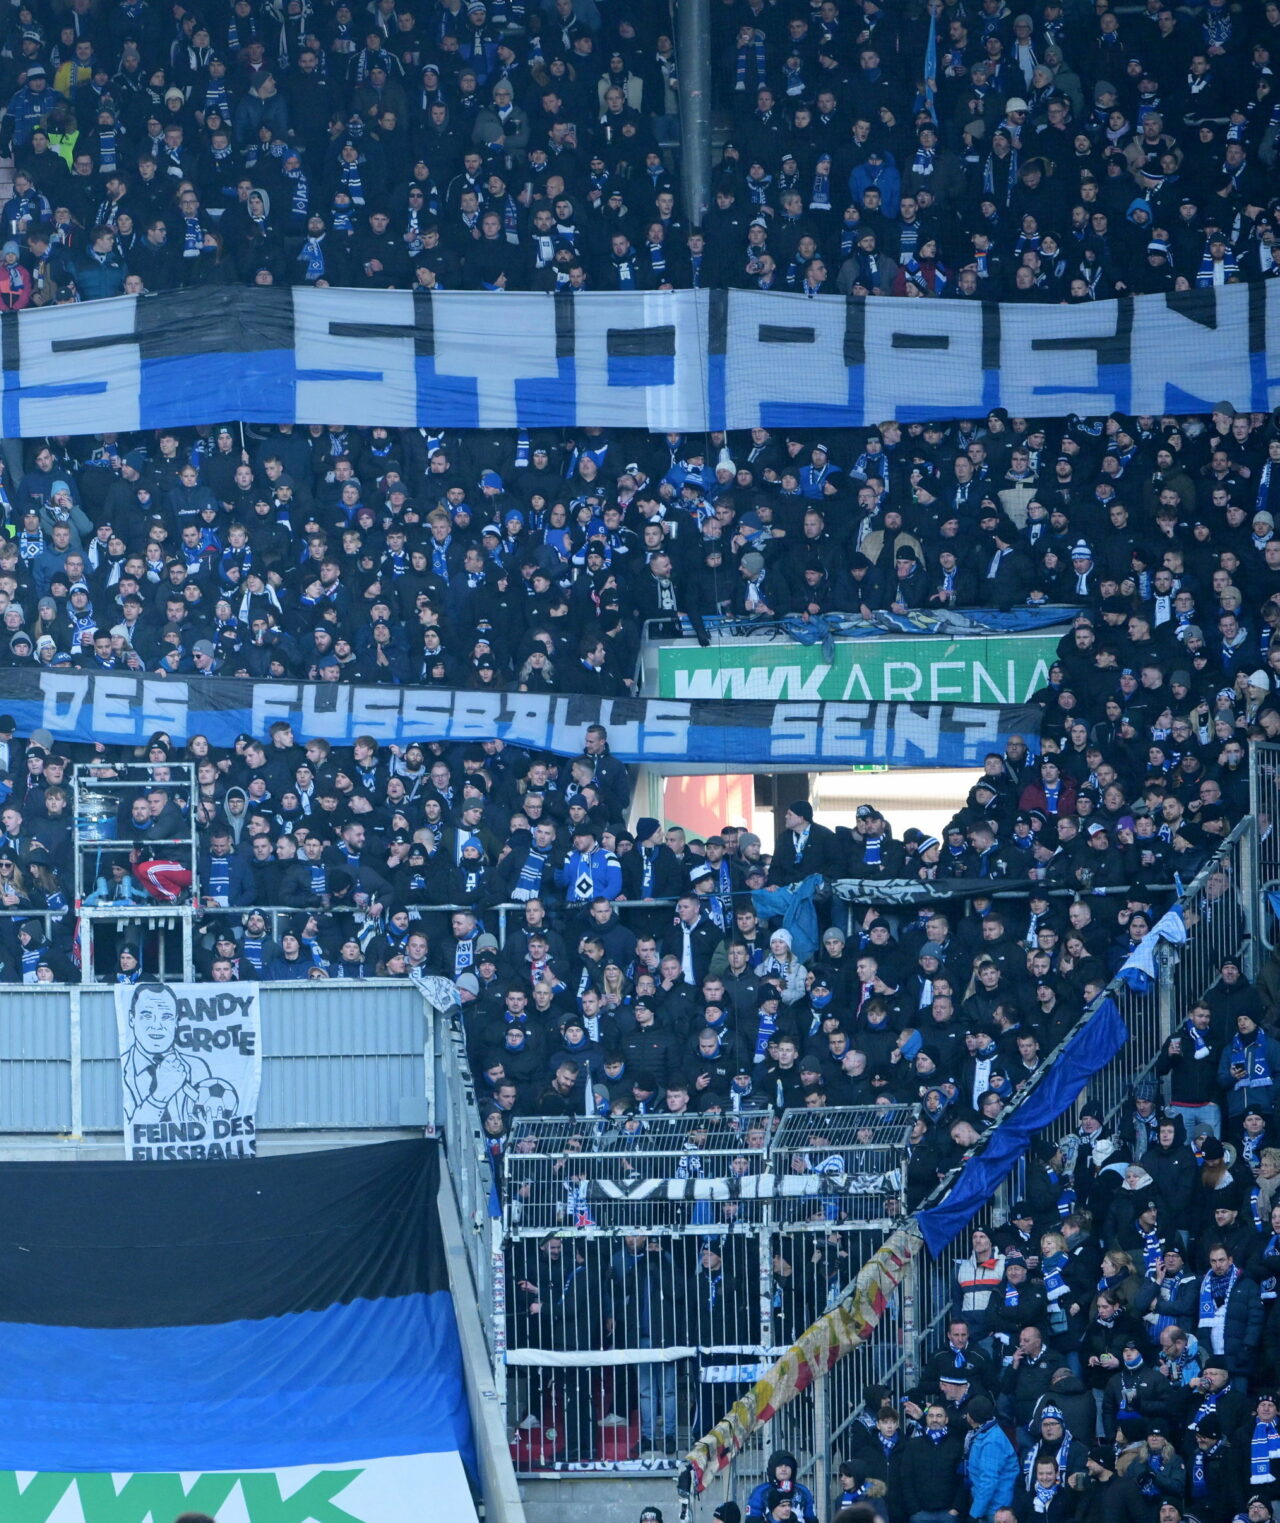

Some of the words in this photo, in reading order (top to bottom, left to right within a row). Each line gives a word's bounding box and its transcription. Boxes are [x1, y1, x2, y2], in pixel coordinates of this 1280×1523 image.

[674, 664, 832, 701] WWK
[39, 672, 189, 738] DES
[251, 683, 692, 756] FUSSBALLS
[769, 703, 1001, 763] SEIN?
[177, 992, 255, 1022] ANDY
[174, 1024, 256, 1056] GROTE
[133, 1121, 207, 1144] FEIND
[212, 1115, 255, 1140] DES
[132, 1140, 257, 1160] FUSSBALLS
